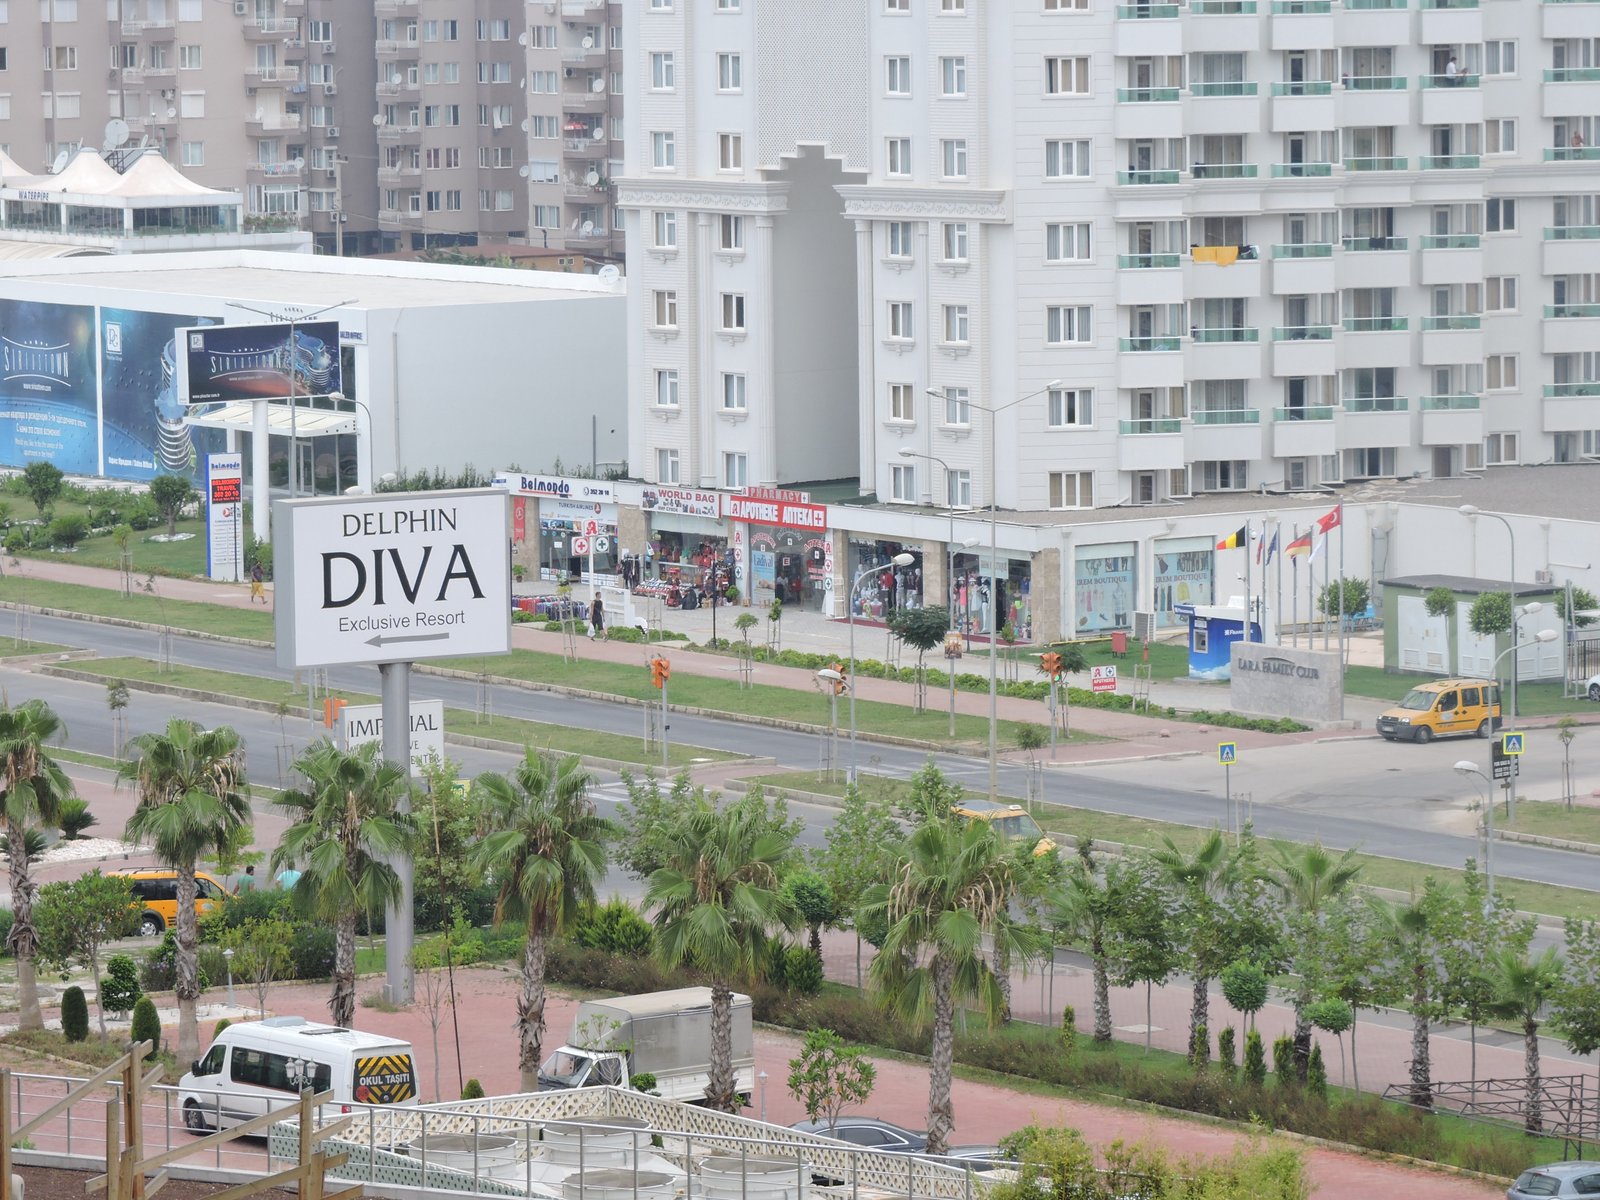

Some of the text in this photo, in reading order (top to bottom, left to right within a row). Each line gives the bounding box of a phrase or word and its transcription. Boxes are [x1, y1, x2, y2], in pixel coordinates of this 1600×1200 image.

[19, 190, 49, 201] WATERPIPE
[210, 351, 281, 373] SIRIUSTOWN
[211, 462, 240, 470] Belmondo
[521, 476, 570, 494] Belmondo
[658, 489, 715, 503] WORLD BAG
[751, 487, 800, 502] PHARMACY
[576, 503, 594, 511] AIRLINES
[741, 501, 779, 522] APOTHEKE
[342, 507, 457, 537] DELPHIN
[320, 543, 486, 609] DIVA
[1094, 575, 1128, 585] BOUTIQUE
[1174, 572, 1208, 582] BOUTIQUE
[338, 609, 466, 633] Exclusive Resort
[1238, 657, 1320, 679] LARA FAMILY CLUB
[359, 1073, 410, 1086] OKUL TAŞITI
